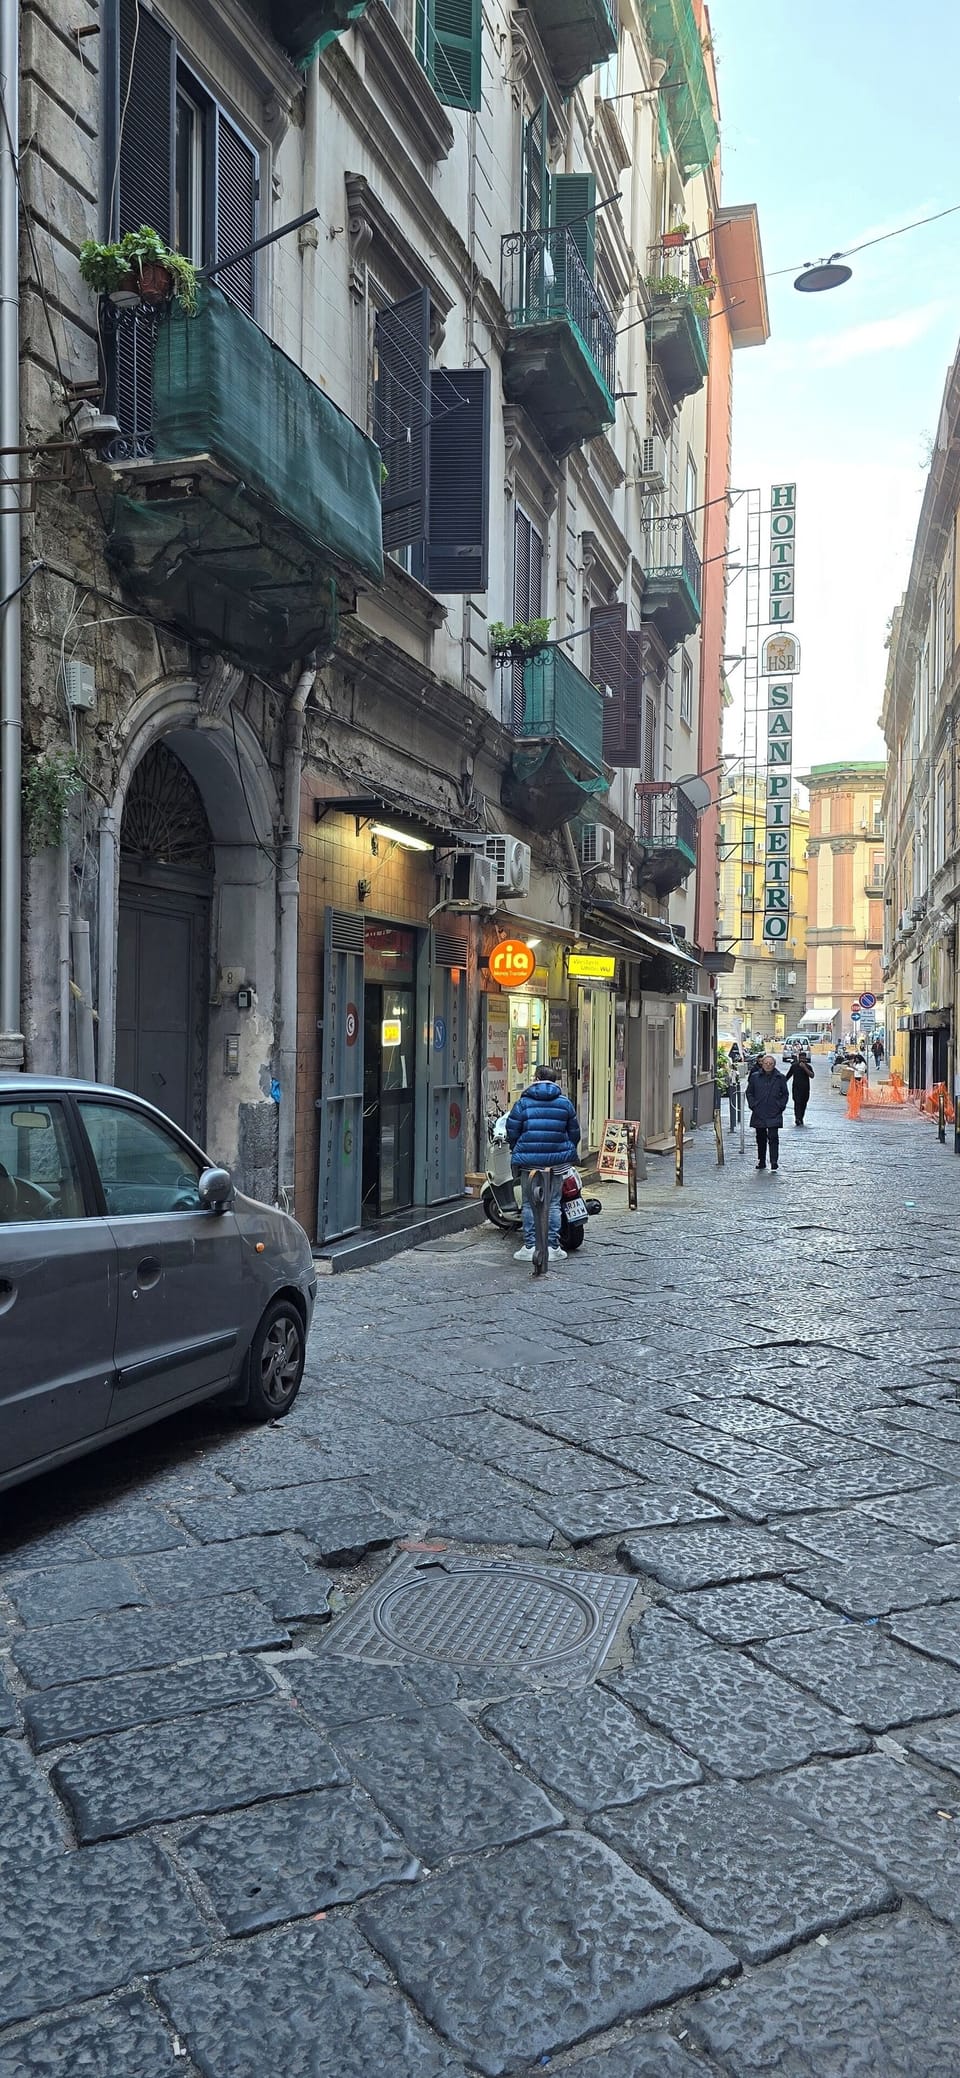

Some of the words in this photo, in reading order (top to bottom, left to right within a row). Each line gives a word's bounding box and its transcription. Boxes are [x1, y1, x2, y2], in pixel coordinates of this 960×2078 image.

[772, 486, 794, 620] HOTEL
[768, 655, 795, 672] HSP
[769, 685, 790, 762] SAN
[765, 777, 788, 937] PIETRO
[494, 945, 528, 969] ria
